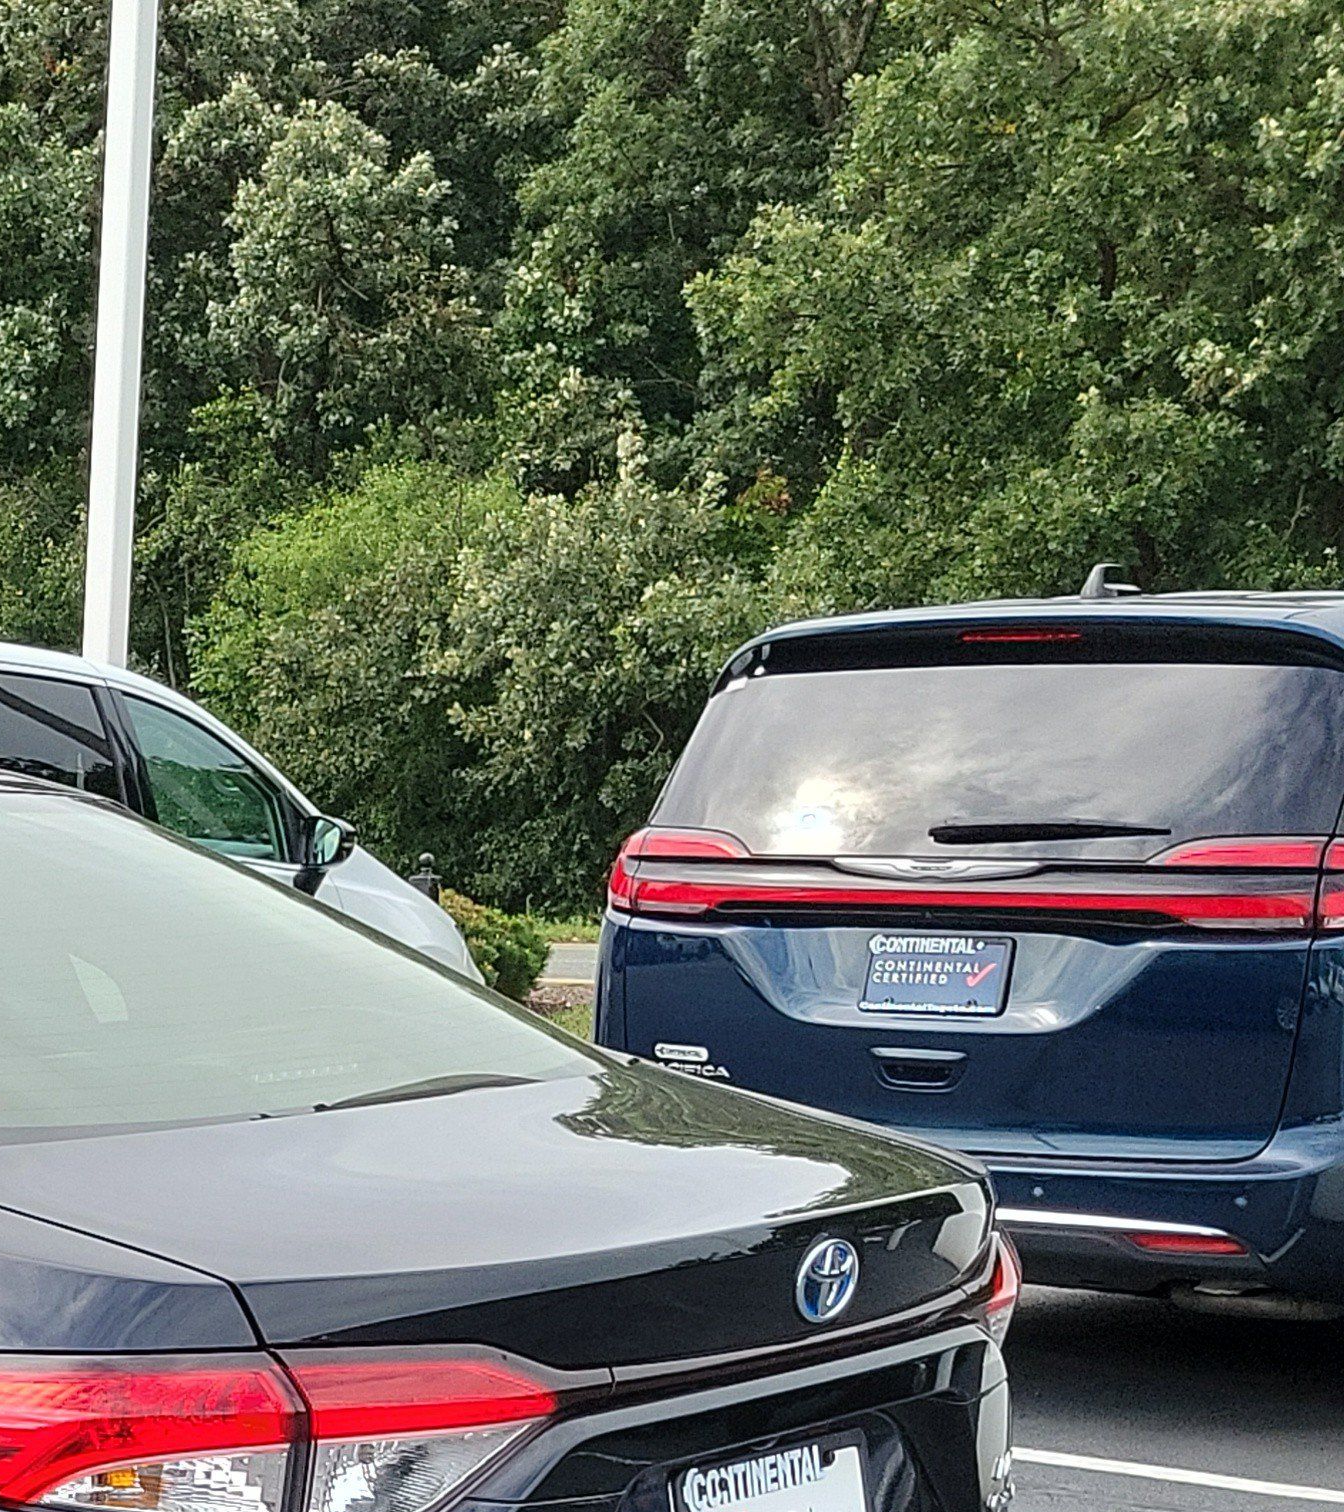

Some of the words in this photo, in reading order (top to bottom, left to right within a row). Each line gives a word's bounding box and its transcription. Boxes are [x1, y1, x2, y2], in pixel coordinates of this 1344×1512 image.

[876, 936, 976, 954] CONTINENTAL
[874, 960, 980, 974] CONTINENTAL
[872, 972, 948, 985] CERTIFIED
[691, 1445, 828, 1510] CONTINENTAL
